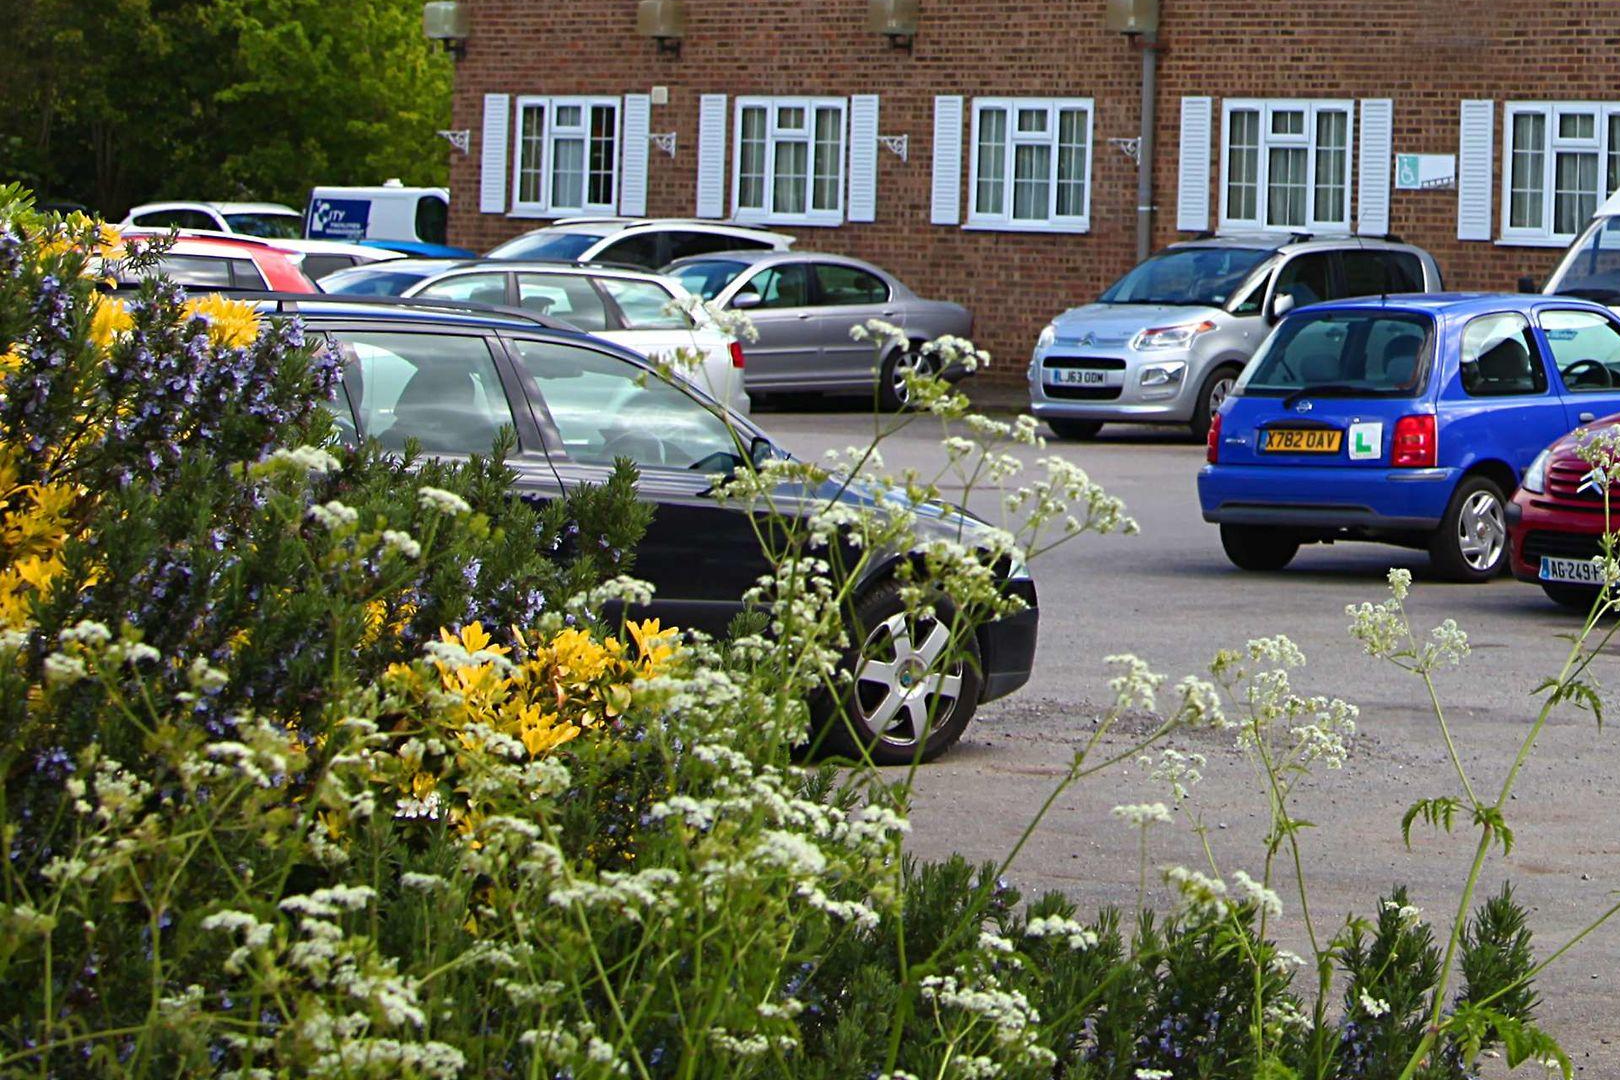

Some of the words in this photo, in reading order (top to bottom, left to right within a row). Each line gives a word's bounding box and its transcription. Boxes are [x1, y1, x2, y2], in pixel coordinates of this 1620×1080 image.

[1266, 430, 1303, 450] X782
[1306, 430, 1336, 449] OAV
[1355, 432, 1372, 453] L
